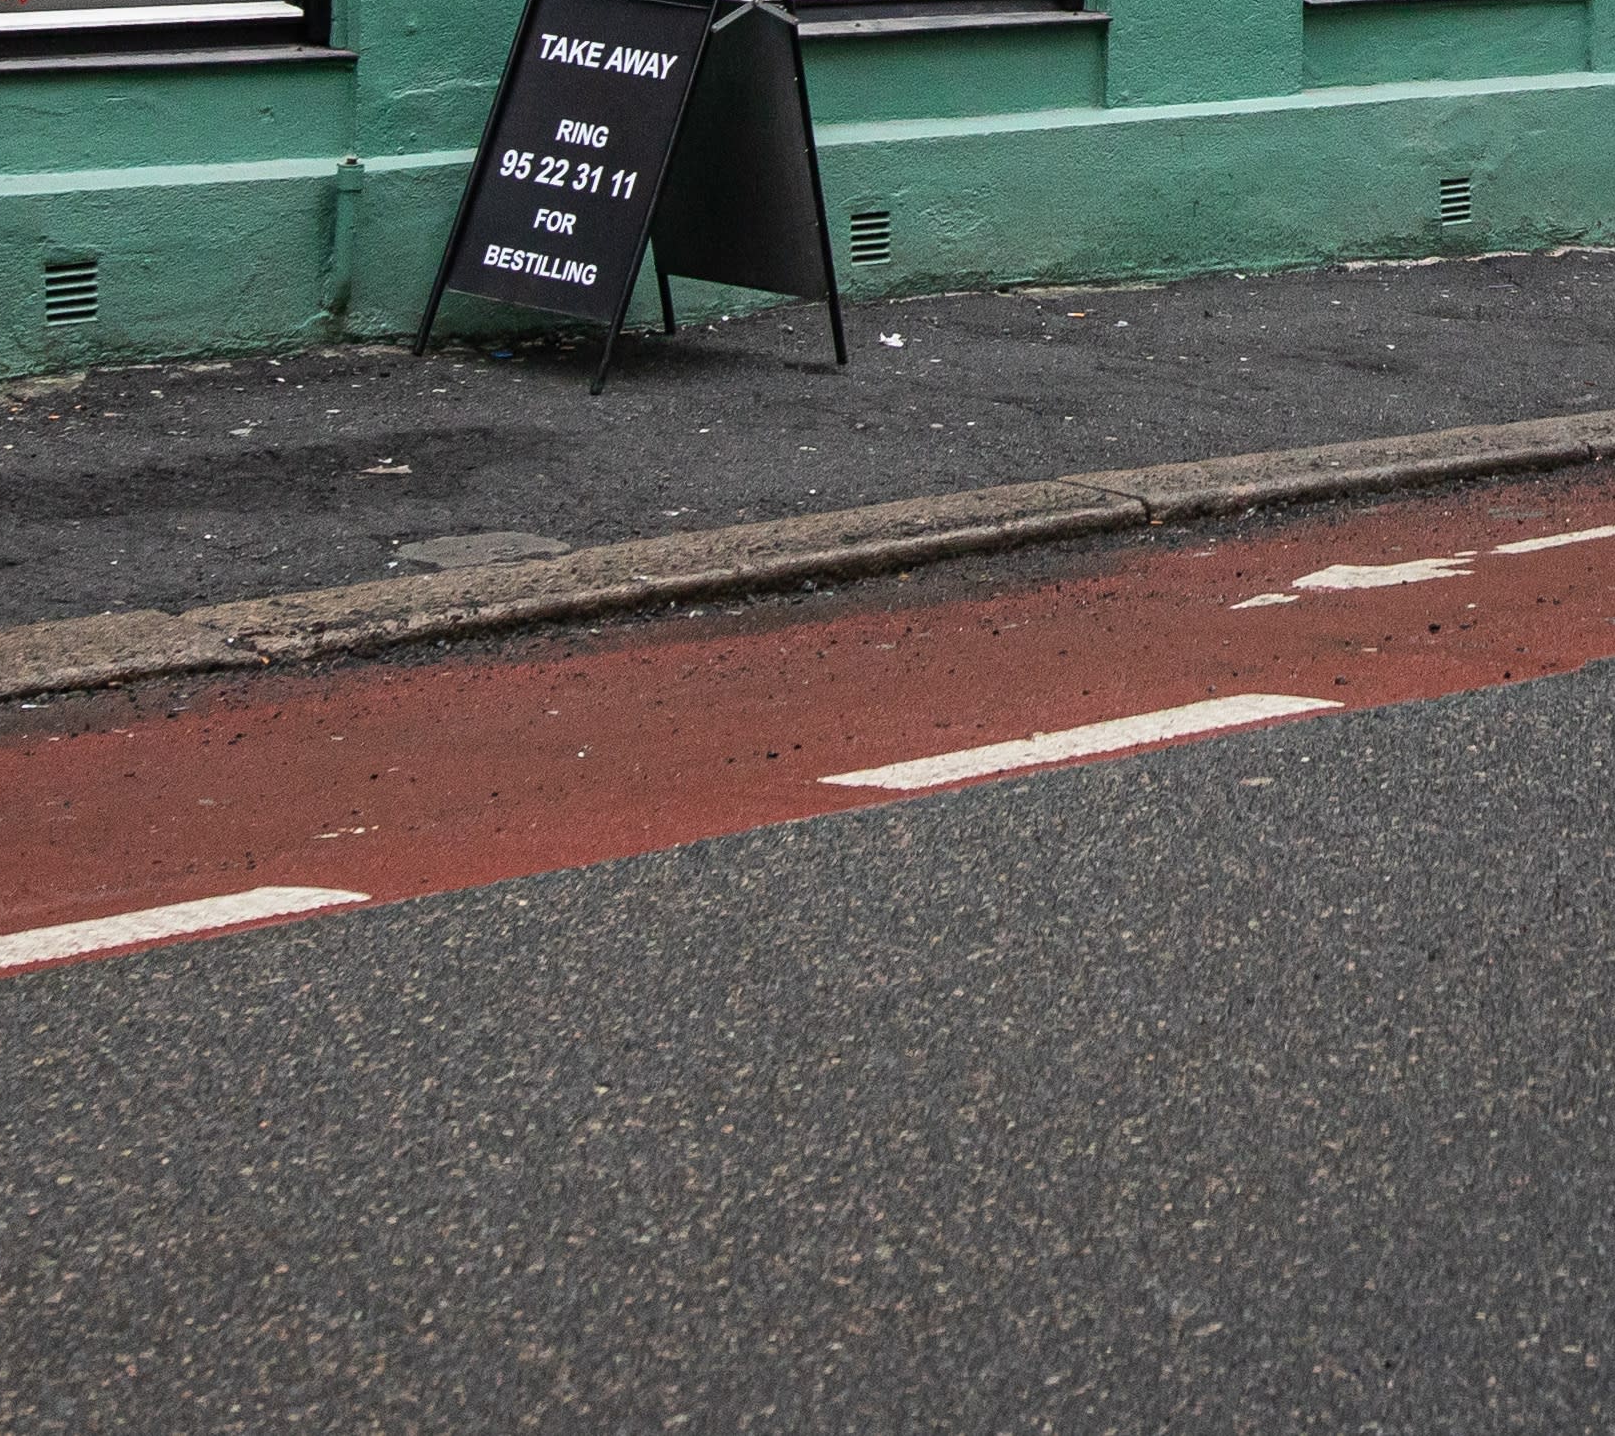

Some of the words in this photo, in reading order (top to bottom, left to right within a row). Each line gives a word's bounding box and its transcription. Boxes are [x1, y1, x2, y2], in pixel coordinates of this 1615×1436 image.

[539, 33, 606, 69] TAKE
[604, 46, 678, 81] AWAY
[555, 118, 610, 148] RING
[499, 149, 532, 180] 95
[534, 155, 568, 186] 22
[571, 162, 604, 195] 31
[610, 169, 638, 200] 11
[533, 207, 576, 236] FOR
[483, 243, 598, 286] BESTILLING
